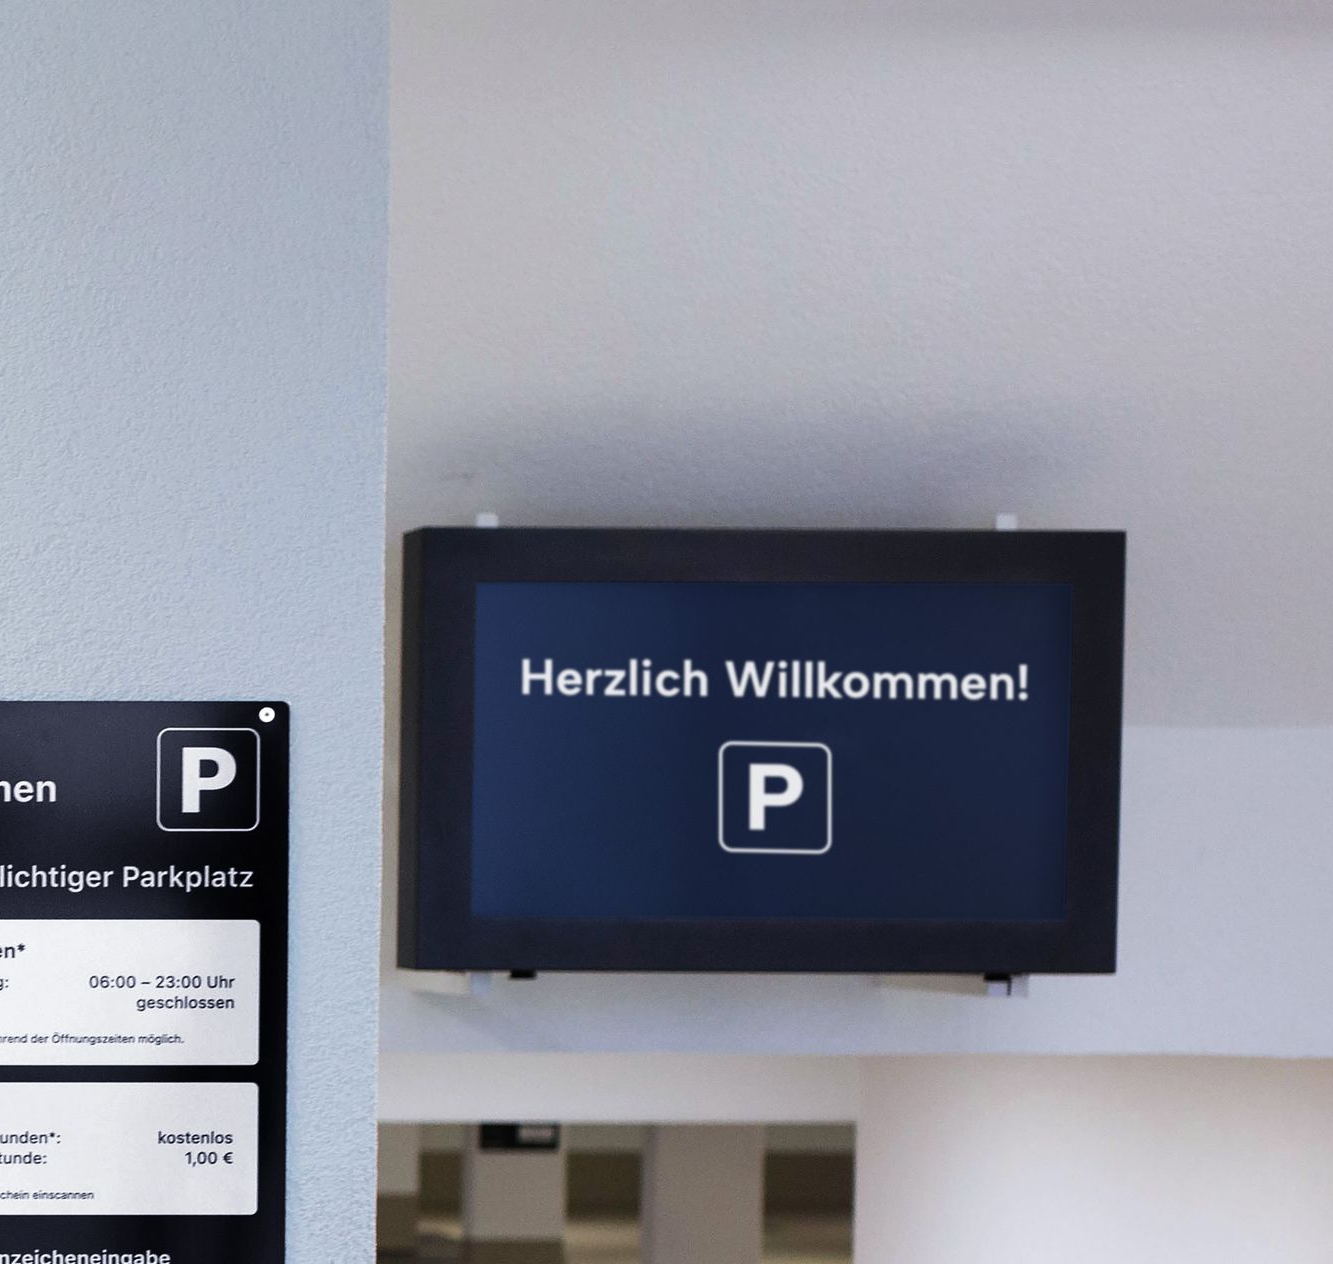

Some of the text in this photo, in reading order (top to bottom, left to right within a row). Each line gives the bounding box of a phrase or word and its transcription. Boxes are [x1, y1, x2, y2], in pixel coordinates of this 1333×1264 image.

[521, 658, 1030, 702] Herzlich Willkommen!
[181, 746, 238, 813] P
[748, 763, 805, 830] P
[122, 865, 254, 891] Parkplatz
[88, 975, 136, 990] 06:00
[155, 975, 203, 990] 23:00
[206, 975, 236, 990] Uhr
[136, 996, 235, 1011] geschlossen
[30, 1033, 49, 1044] der
[51, 1031, 135, 1046] Öffnungszeiten
[138, 1032, 185, 1047] möglich.
[157, 1130, 233, 1145] kostenlos
[184, 1151, 233, 1167] 1,00 €
[32, 1190, 95, 1200] einscannen
